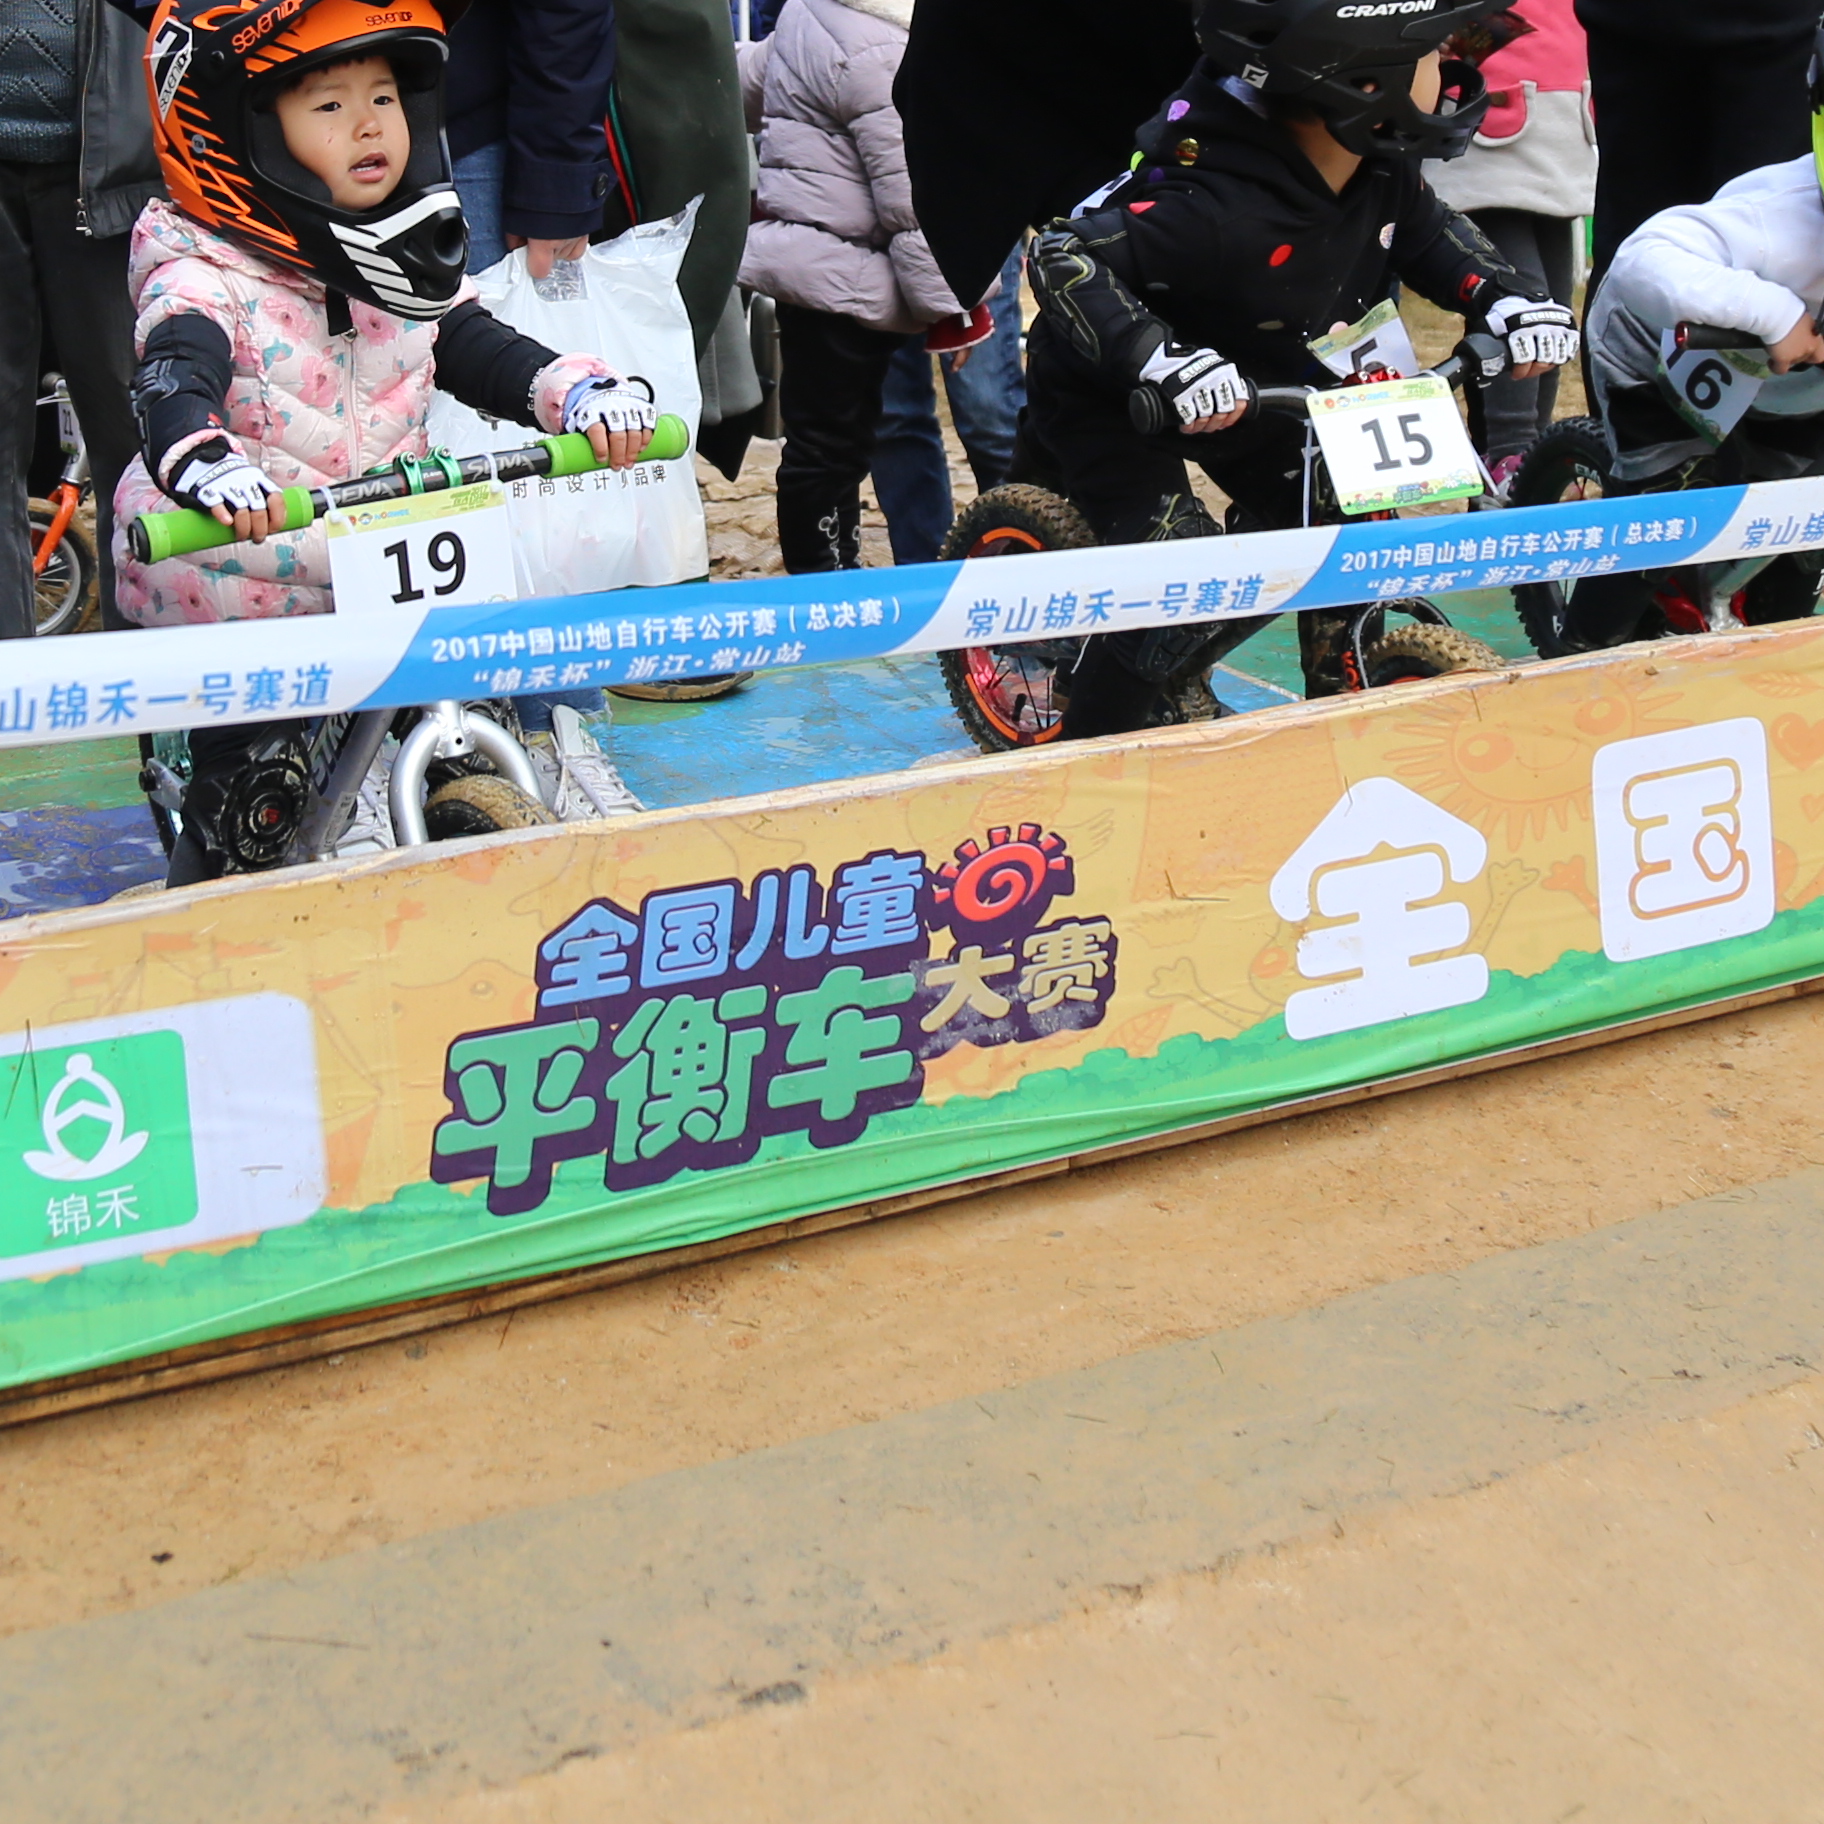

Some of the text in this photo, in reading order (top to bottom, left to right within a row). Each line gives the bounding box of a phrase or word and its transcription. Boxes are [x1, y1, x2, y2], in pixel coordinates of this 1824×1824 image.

[1360, 413, 1434, 472] 15
[383, 531, 467, 605] 19
[1339, 516, 1699, 574] 2017中国山地自行车公开赛（总决赛）
[430, 595, 903, 664] 2017中国山地自行车公开赛（总决赛）
[964, 572, 1266, 639] 常山锦禾一号赛道
[538, 849, 926, 1008] 全国儿童
[919, 919, 1114, 1036] 大赛
[432, 964, 917, 1192] 平衡车
[44, 1184, 141, 1241] 锦禾
